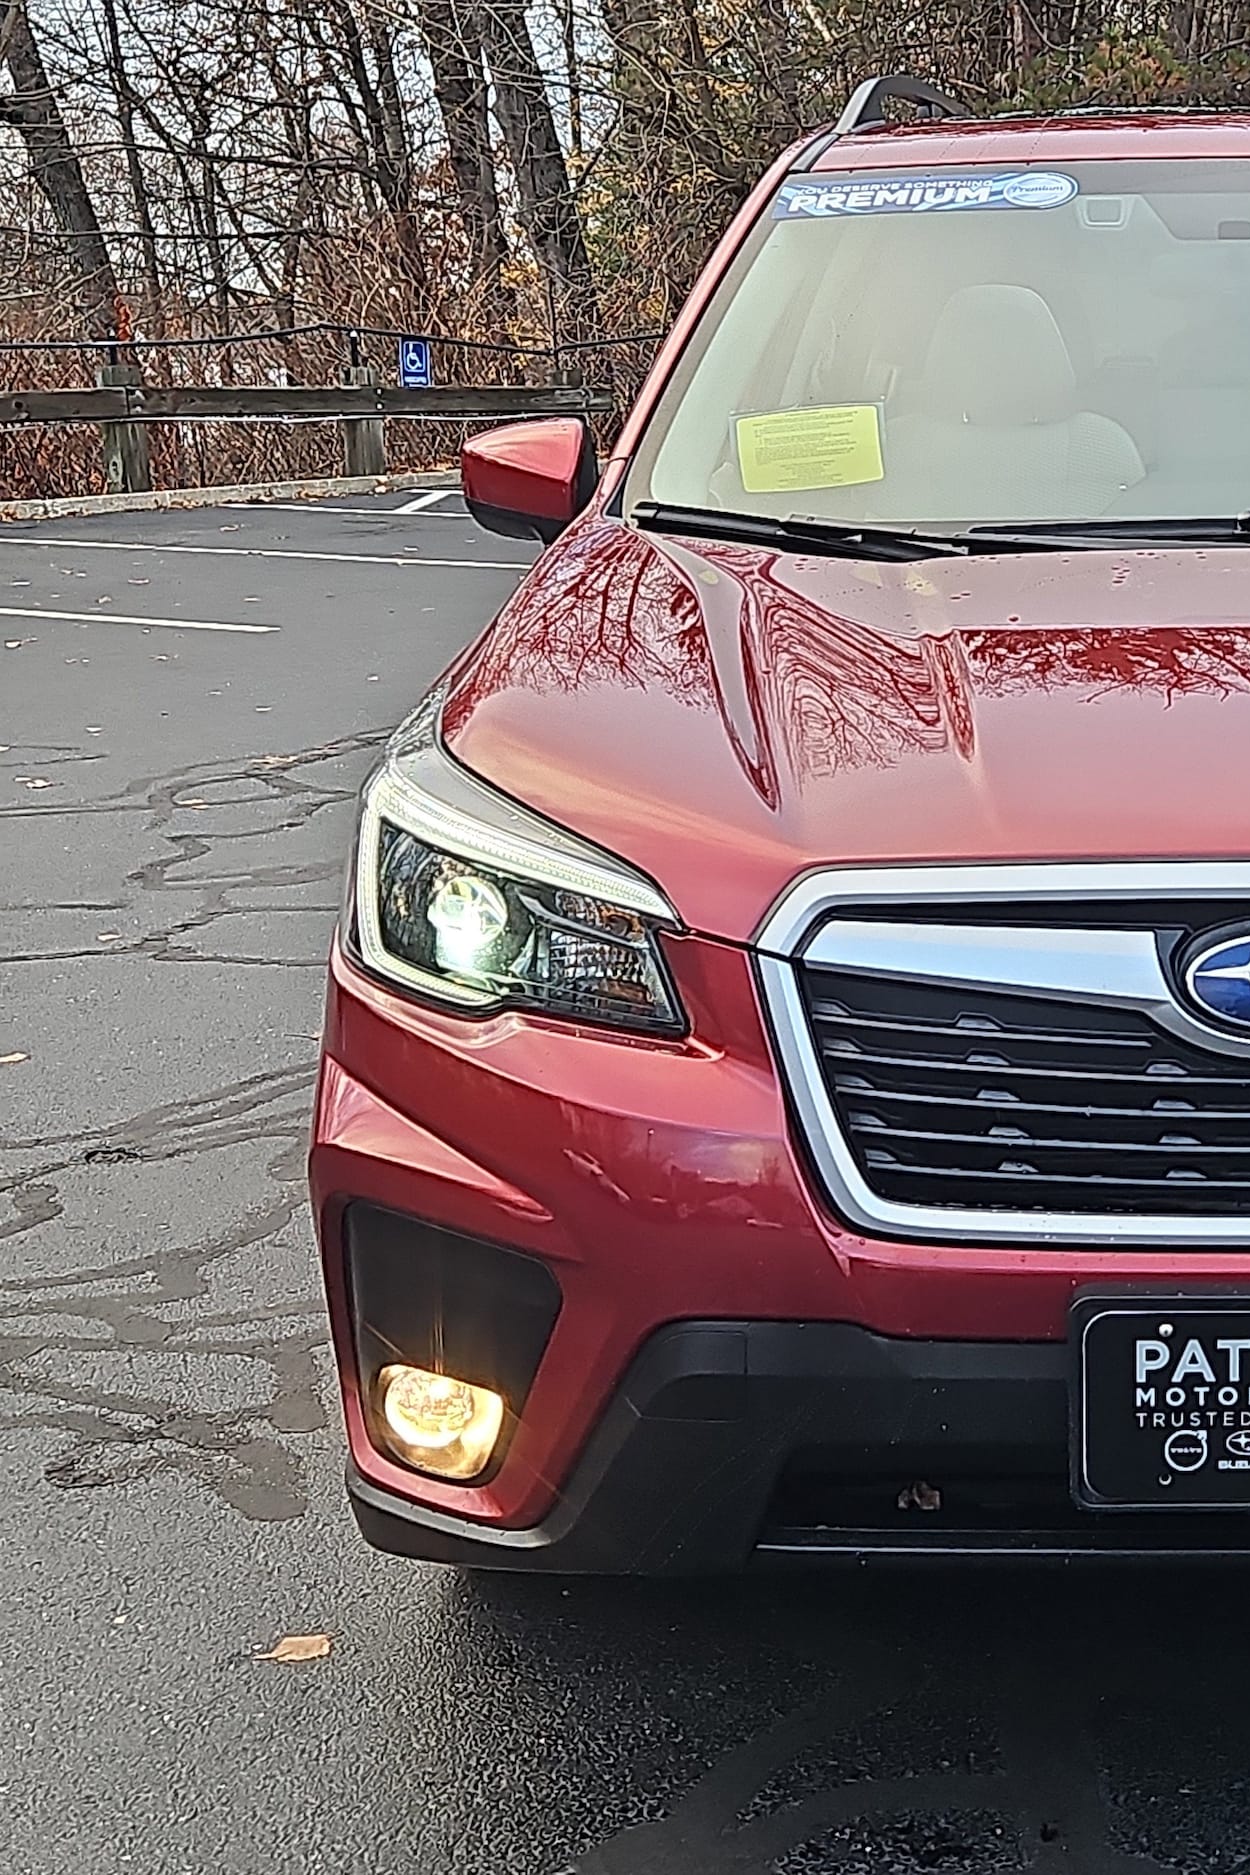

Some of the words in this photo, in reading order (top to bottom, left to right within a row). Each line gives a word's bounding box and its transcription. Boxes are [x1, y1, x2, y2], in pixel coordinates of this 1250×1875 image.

[831, 182, 900, 193] DESERVE
[904, 179, 993, 189] SOMETHING
[1010, 184, 1064, 193] Premium
[788, 187, 992, 212] PREMIUM
